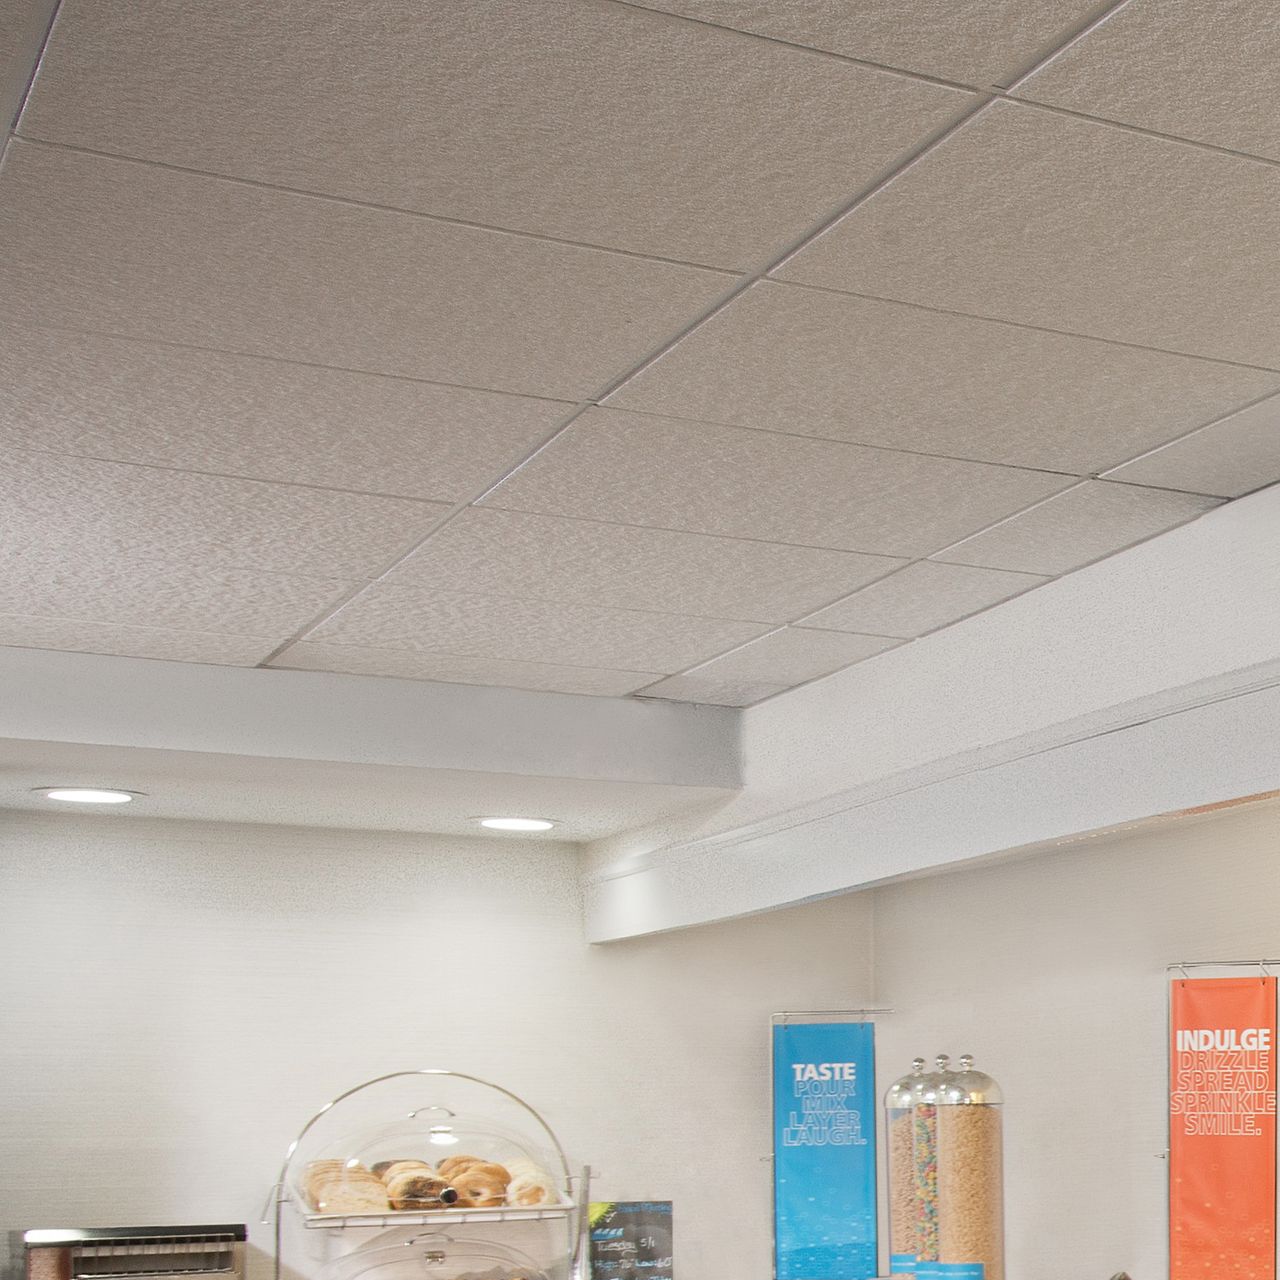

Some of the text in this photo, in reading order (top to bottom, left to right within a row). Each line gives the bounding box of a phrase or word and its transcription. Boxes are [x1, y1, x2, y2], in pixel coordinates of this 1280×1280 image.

[1176, 1028, 1271, 1051] INDULGE
[792, 1062, 856, 1081] TASTE
[1178, 1050, 1269, 1072] DRIZZLE
[794, 1080, 856, 1097] POUR
[1177, 1070, 1269, 1093] SPREAD
[802, 1095, 847, 1113] MIX
[1170, 1091, 1276, 1114] SPRINKLE
[790, 1110, 861, 1129] LAYER
[1184, 1112, 1262, 1136] SMILE.
[783, 1126, 868, 1146] LAUGH.
